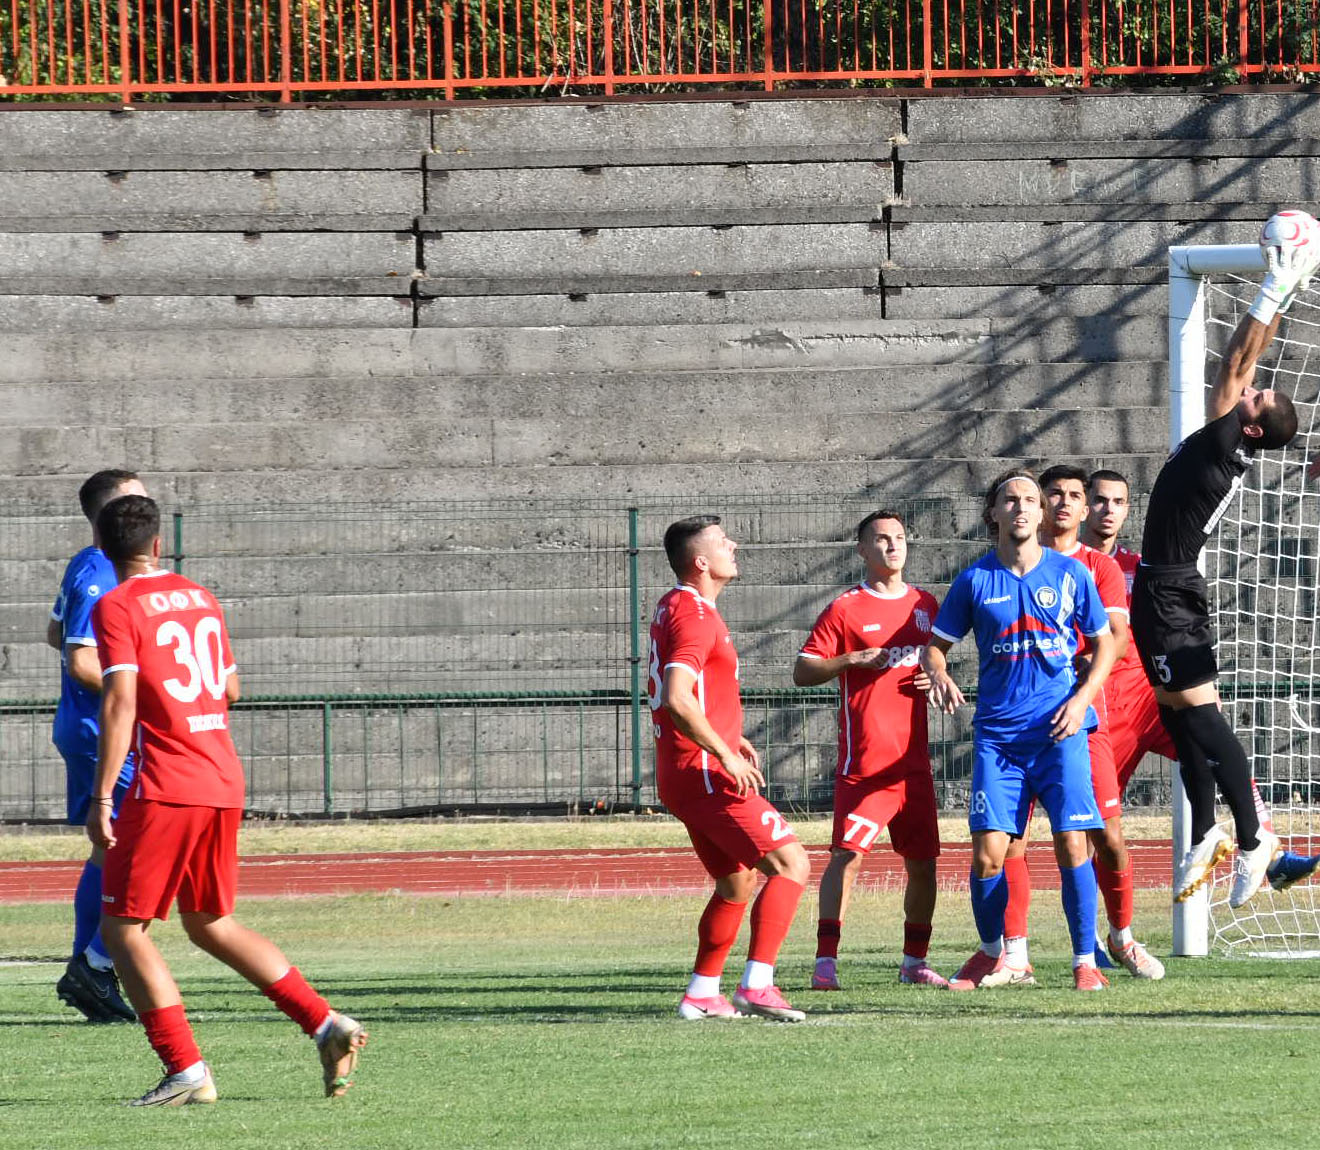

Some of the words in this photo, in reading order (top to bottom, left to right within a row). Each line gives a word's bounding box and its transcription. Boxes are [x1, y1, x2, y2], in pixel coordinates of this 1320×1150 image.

[150, 590, 210, 612] ОФК
[992, 636, 1064, 654] COMPASS
[156, 616, 227, 703] 30
[970, 790, 986, 815] 18
[844, 813, 879, 848] 77
